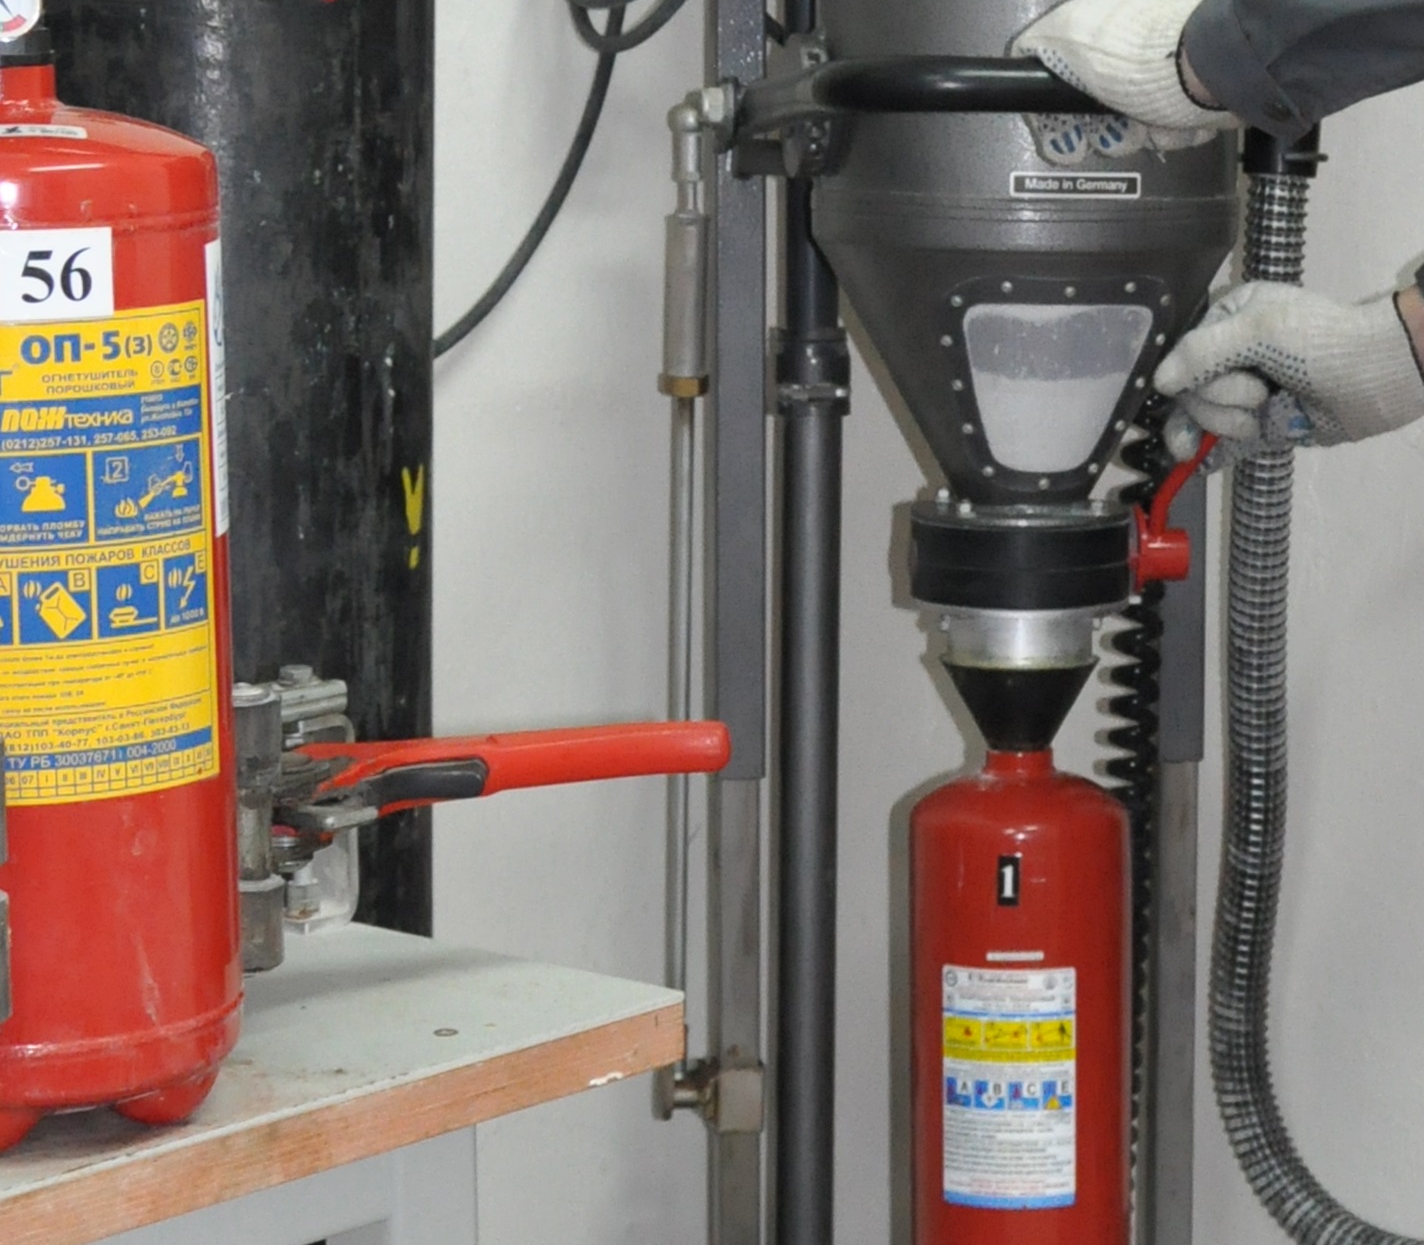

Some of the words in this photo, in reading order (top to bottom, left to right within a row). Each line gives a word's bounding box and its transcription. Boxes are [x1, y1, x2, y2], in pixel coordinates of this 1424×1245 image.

[1024, 178, 1060, 190] Made
[1062, 178, 1074, 190] in
[1076, 178, 1128, 192] Germany
[21, 247, 93, 303] 56
[42, 368, 139, 384] ОГНЕТУШИТЕЛЬ
[46, 380, 136, 394] ПОРОШКОВЫЙ
[112, 461, 122, 477] 2
[66, 548, 135, 566] ПОЖАРОВ
[142, 539, 191, 556] КЛАССОВ
[8, 757, 27, 768] ТУ
[31, 755, 51, 768] РБ
[1001, 863, 1015, 898] 1
